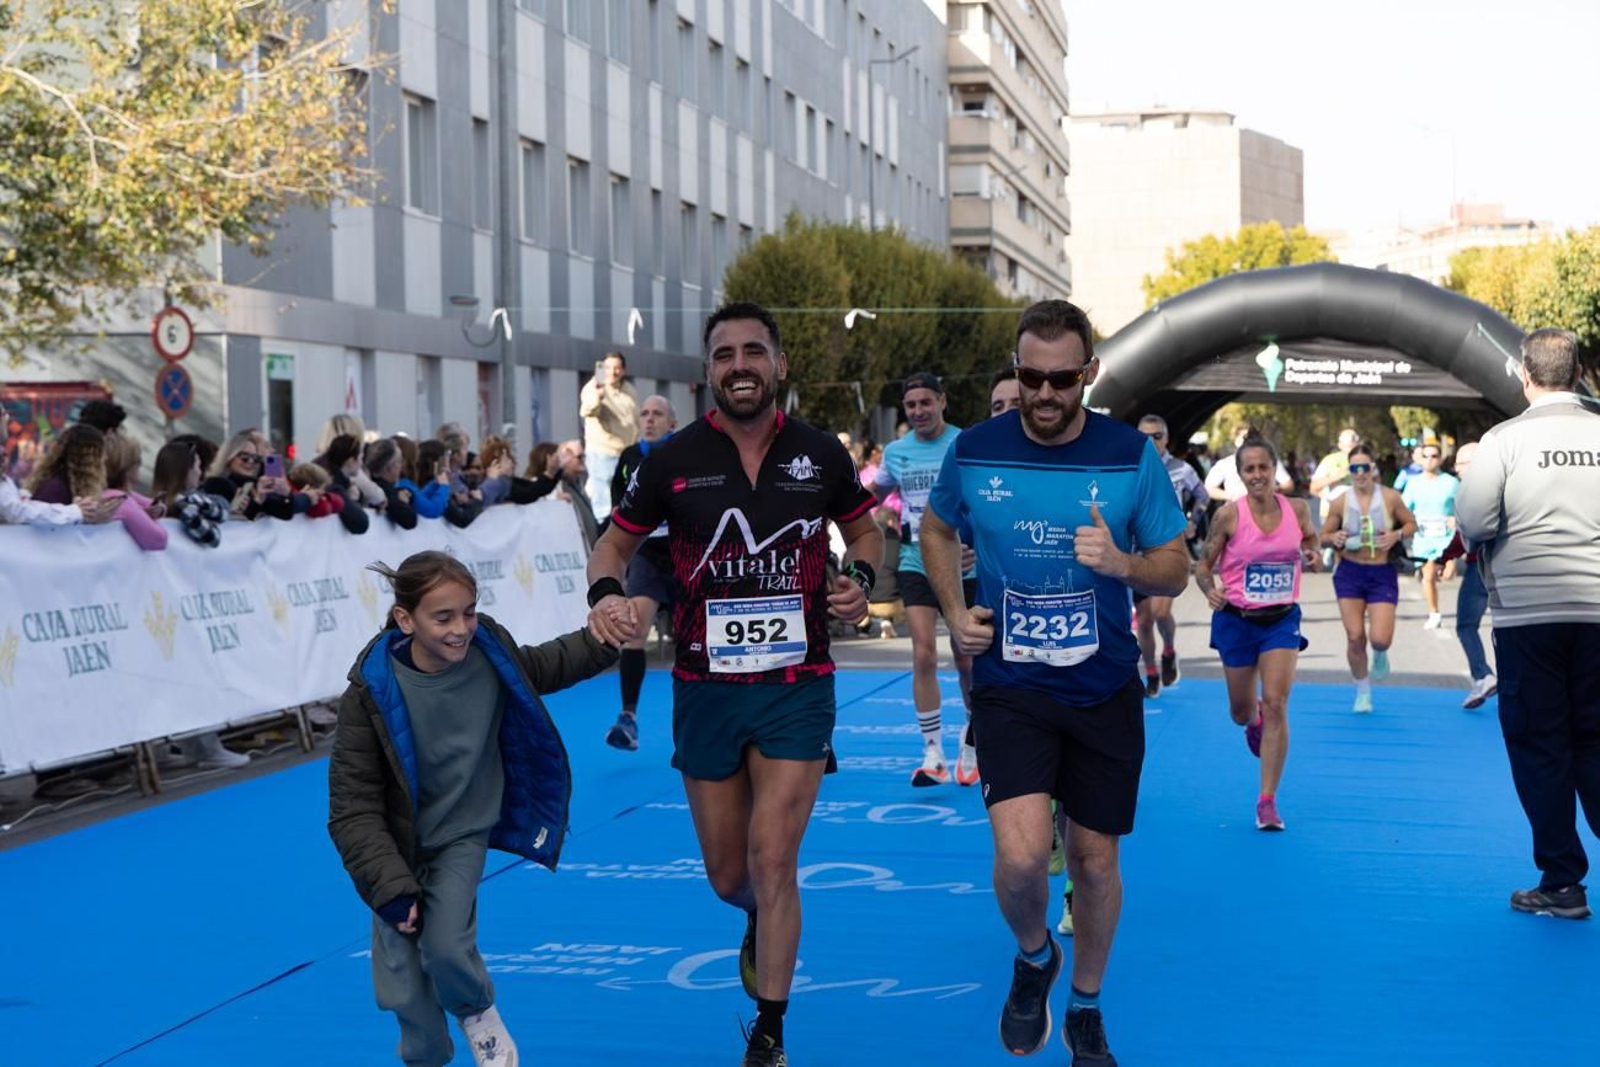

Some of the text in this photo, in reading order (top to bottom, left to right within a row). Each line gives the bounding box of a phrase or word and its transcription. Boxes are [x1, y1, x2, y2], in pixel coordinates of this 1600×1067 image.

[167, 325, 177, 344] 6
[1285, 358, 1411, 375] Patronato Municipal de
[1285, 370, 1336, 384] Deportes
[1337, 372, 1353, 384] de
[1537, 450, 1600, 469] Jom
[758, 575, 803, 591] TRAIL
[1248, 571, 1292, 589] 2053
[22, 602, 129, 643] CAJA RURAL
[1010, 611, 1090, 641] 2232
[725, 618, 788, 646] 952
[744, 644, 773, 653] ANTONIO
[1042, 640, 1057, 648] LUIS
[62, 637, 112, 678] JAÉN
[486, 964, 615, 975] MED
